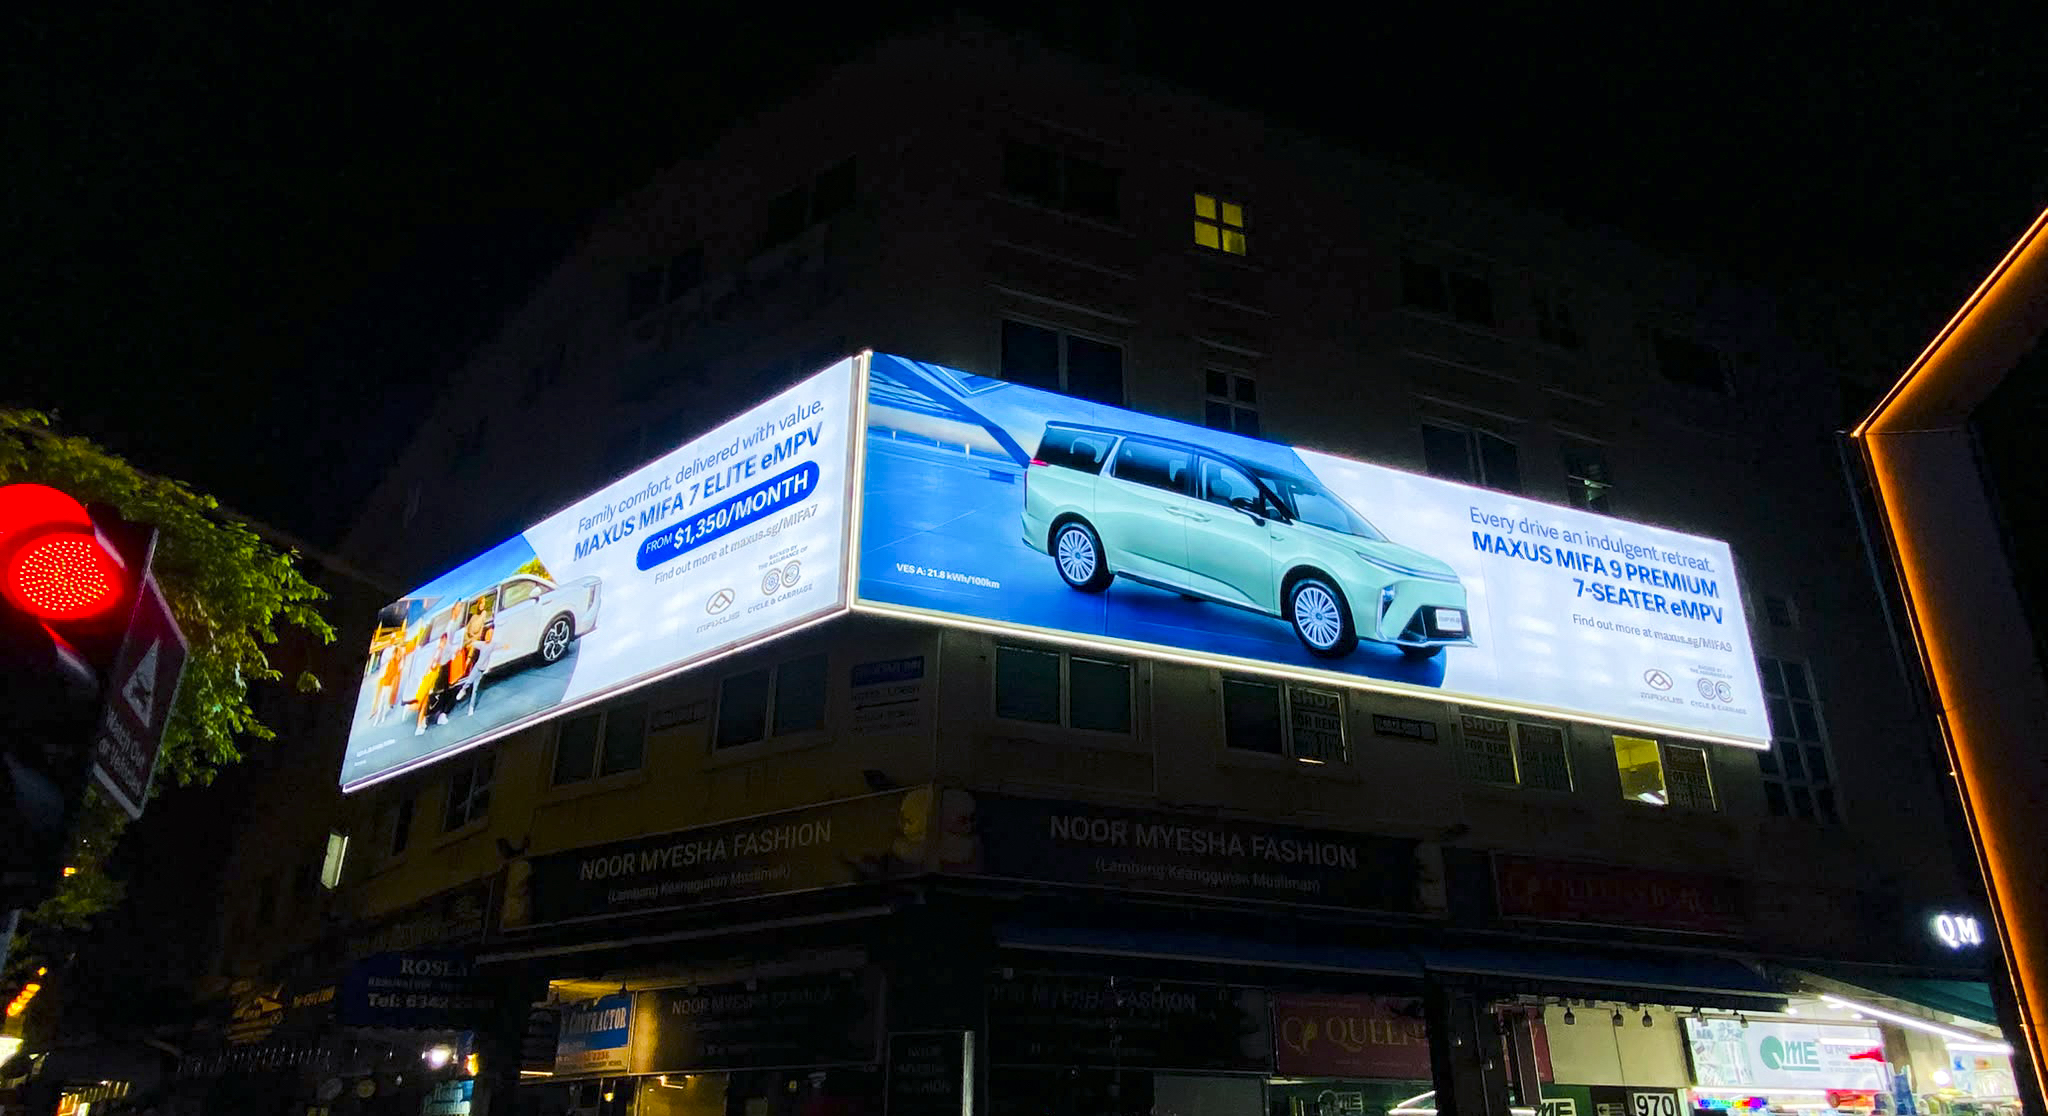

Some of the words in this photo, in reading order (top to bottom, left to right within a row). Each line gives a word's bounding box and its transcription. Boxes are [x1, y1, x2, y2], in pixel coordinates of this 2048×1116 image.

[573, 516, 636, 562] MAXUS
[638, 492, 684, 530] MIFA
[689, 483, 701, 506] 7
[703, 454, 757, 500] ELITE
[761, 421, 823, 470] eMPV
[578, 504, 617, 534] Family
[618, 475, 672, 513] comfort,
[675, 437, 740, 485] delivered
[742, 421, 775, 451] with
[779, 400, 825, 434] value.
[645, 532, 673, 554] FROM
[673, 469, 809, 550] $1,350/MONTH
[1469, 506, 1515, 534] Every
[1519, 517, 1559, 540] drive
[1563, 530, 1583, 545] an
[1586, 530, 1659, 562] indulgent
[1662, 551, 1715, 573] retreat.
[655, 564, 674, 585] Find
[675, 560, 692, 576] out
[693, 552, 717, 570] more
[719, 544, 729, 558] at
[730, 503, 819, 553] maxus.sg/MIFA7
[896, 563, 915, 574] VES
[916, 566, 926, 576] A:
[946, 571, 1000, 589] kWh/100km
[1472, 530, 1554, 565] MAXUS
[1556, 549, 1607, 577] MIFA
[1610, 561, 1622, 579] 9
[1625, 563, 1720, 599] PREMIUM
[1572, 613, 1595, 627] Find
[1597, 620, 1614, 631] out
[1616, 625, 1641, 636] more
[1642, 628, 1653, 638] at
[1573, 577, 1669, 615] 7-SEATER
[1670, 597, 1723, 625] eMPV
[579, 851, 637, 882] NOOR
[639, 838, 727, 874] MYESHA
[732, 818, 833, 857] FASHION
[1050, 815, 1127, 846] NOOR
[1135, 823, 1246, 857] MYESHA
[1251, 835, 1358, 870] FASHION
[1937, 914, 1982, 949] QM
[1636, 1095, 1676, 1116] 970
